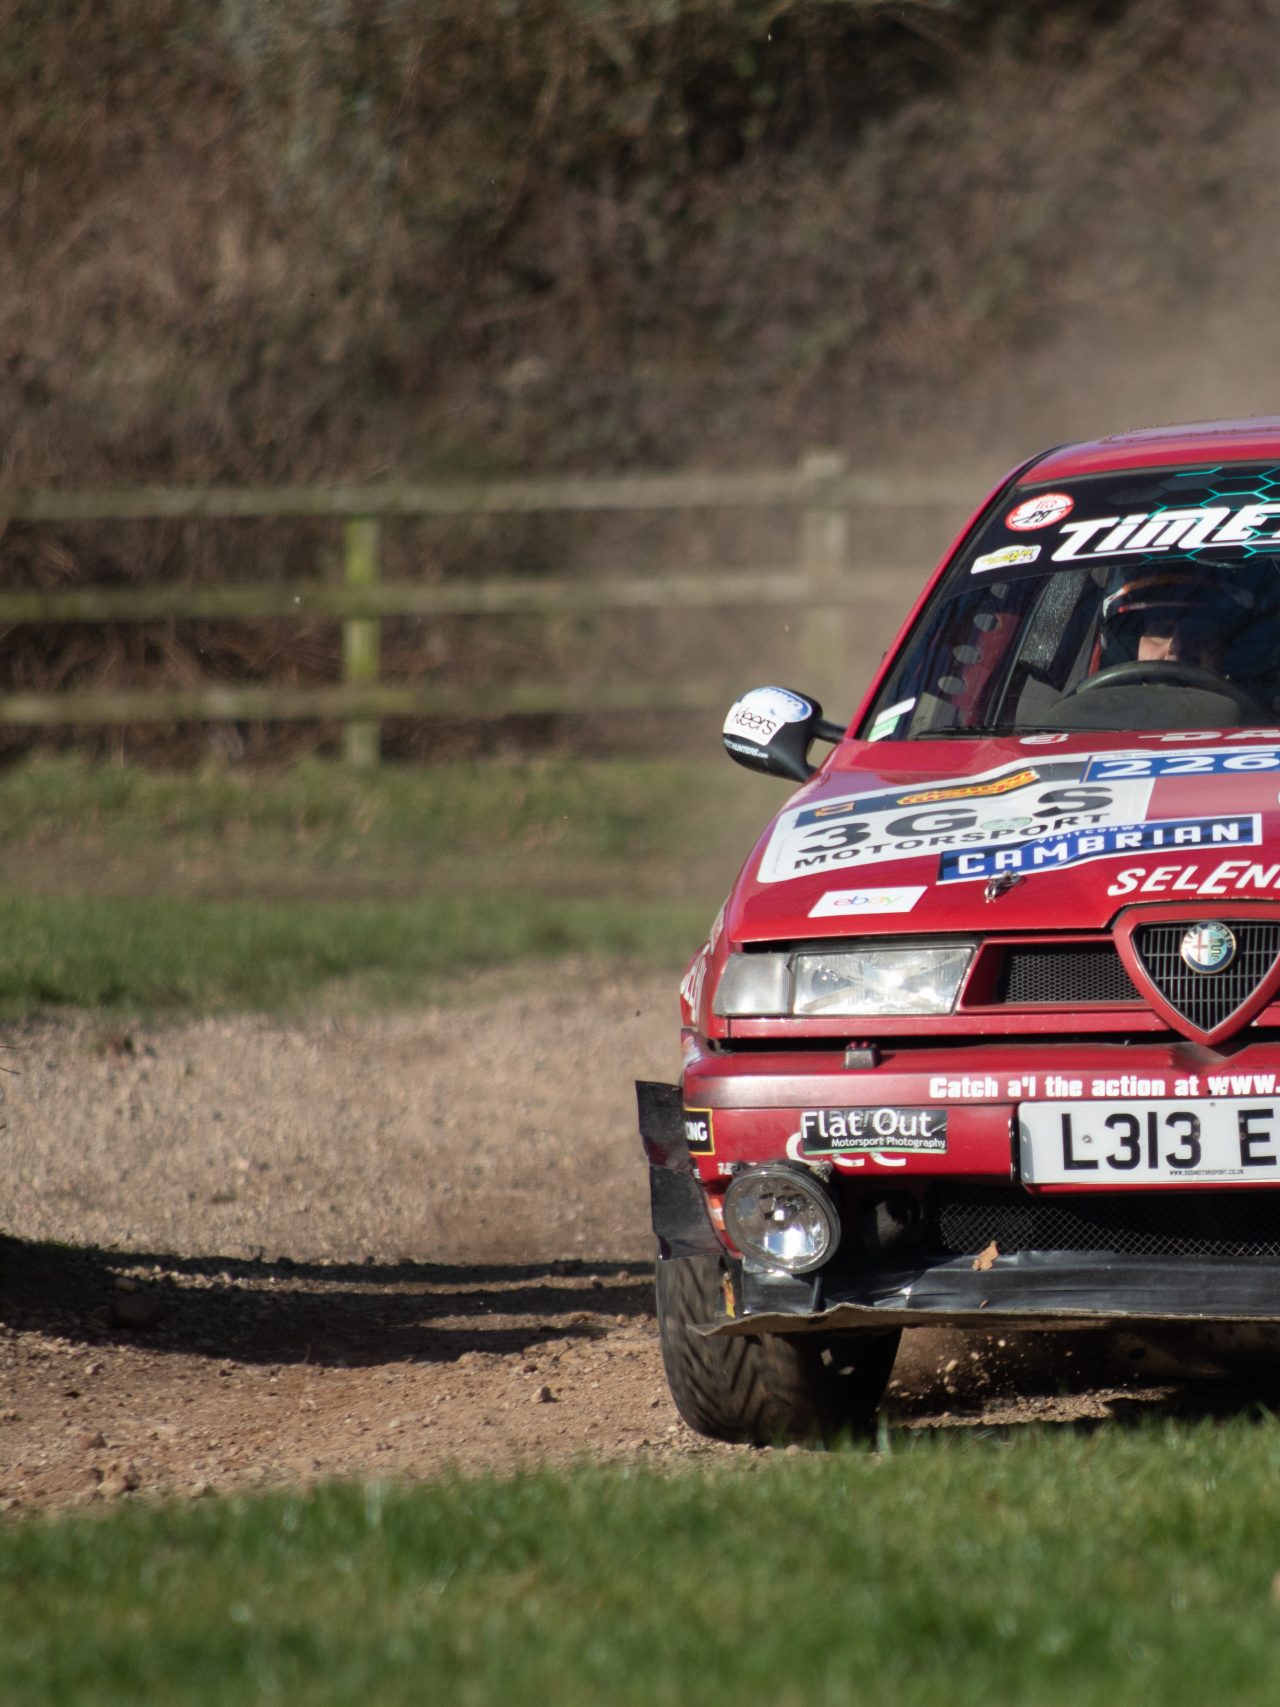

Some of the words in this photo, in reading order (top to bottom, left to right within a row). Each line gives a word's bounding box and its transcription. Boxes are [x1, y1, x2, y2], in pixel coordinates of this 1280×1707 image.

[1096, 752, 1280, 779] 226
[793, 813, 1111, 870] MOTORSPORT
[957, 822, 1240, 875] CAMBRIAN
[833, 895, 906, 906] ebay
[929, 1076, 998, 1098] Catch
[1045, 1077, 1083, 1096] the
[1091, 1075, 1165, 1096] action
[1174, 1075, 1199, 1096] at
[801, 1110, 863, 1139] Flat
[873, 1108, 932, 1137] Out
[831, 1137, 885, 1148] Motorsport
[886, 1137, 946, 1149] Photography
[1061, 1111, 1202, 1170] L313
